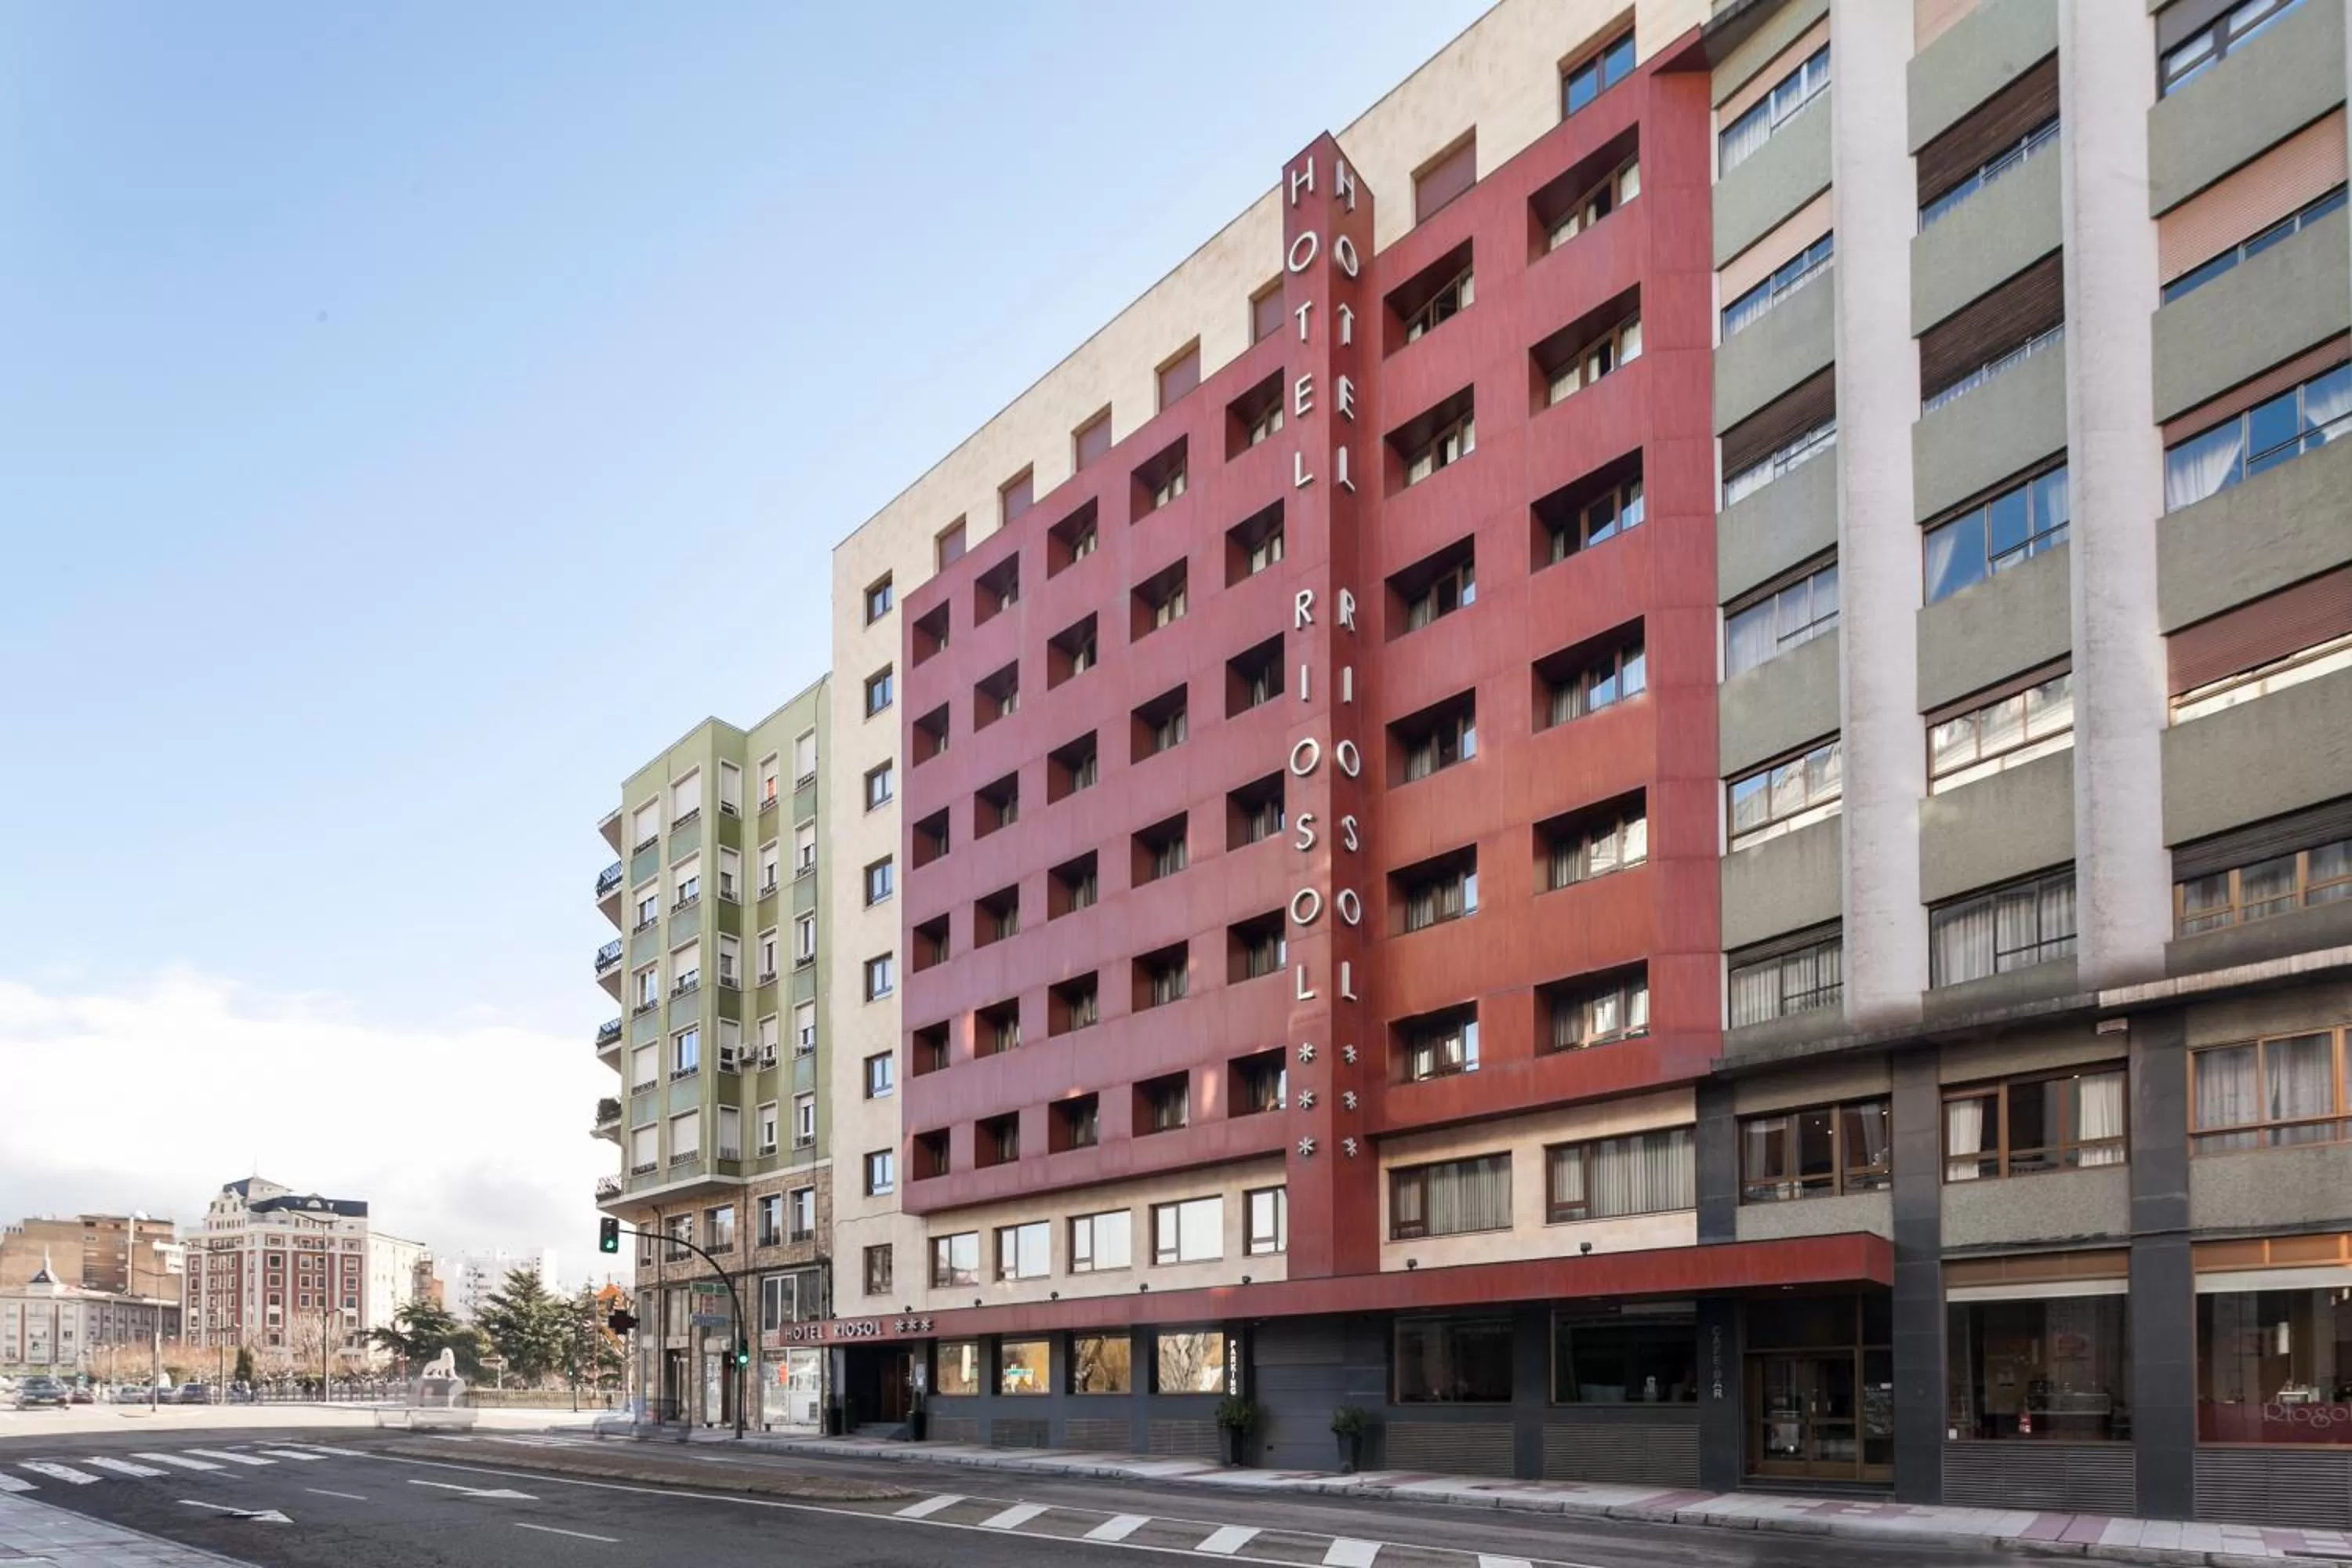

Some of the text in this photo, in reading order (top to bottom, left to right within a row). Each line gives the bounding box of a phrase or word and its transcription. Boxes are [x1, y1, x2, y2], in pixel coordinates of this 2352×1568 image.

[1288, 155, 1323, 1000] HOTEL RIOSOL
[1334, 158, 1361, 1001] HOTEL RIOSOL
[785, 1325, 824, 1341] HOTEL
[833, 1320, 883, 1338] RIOSOL
